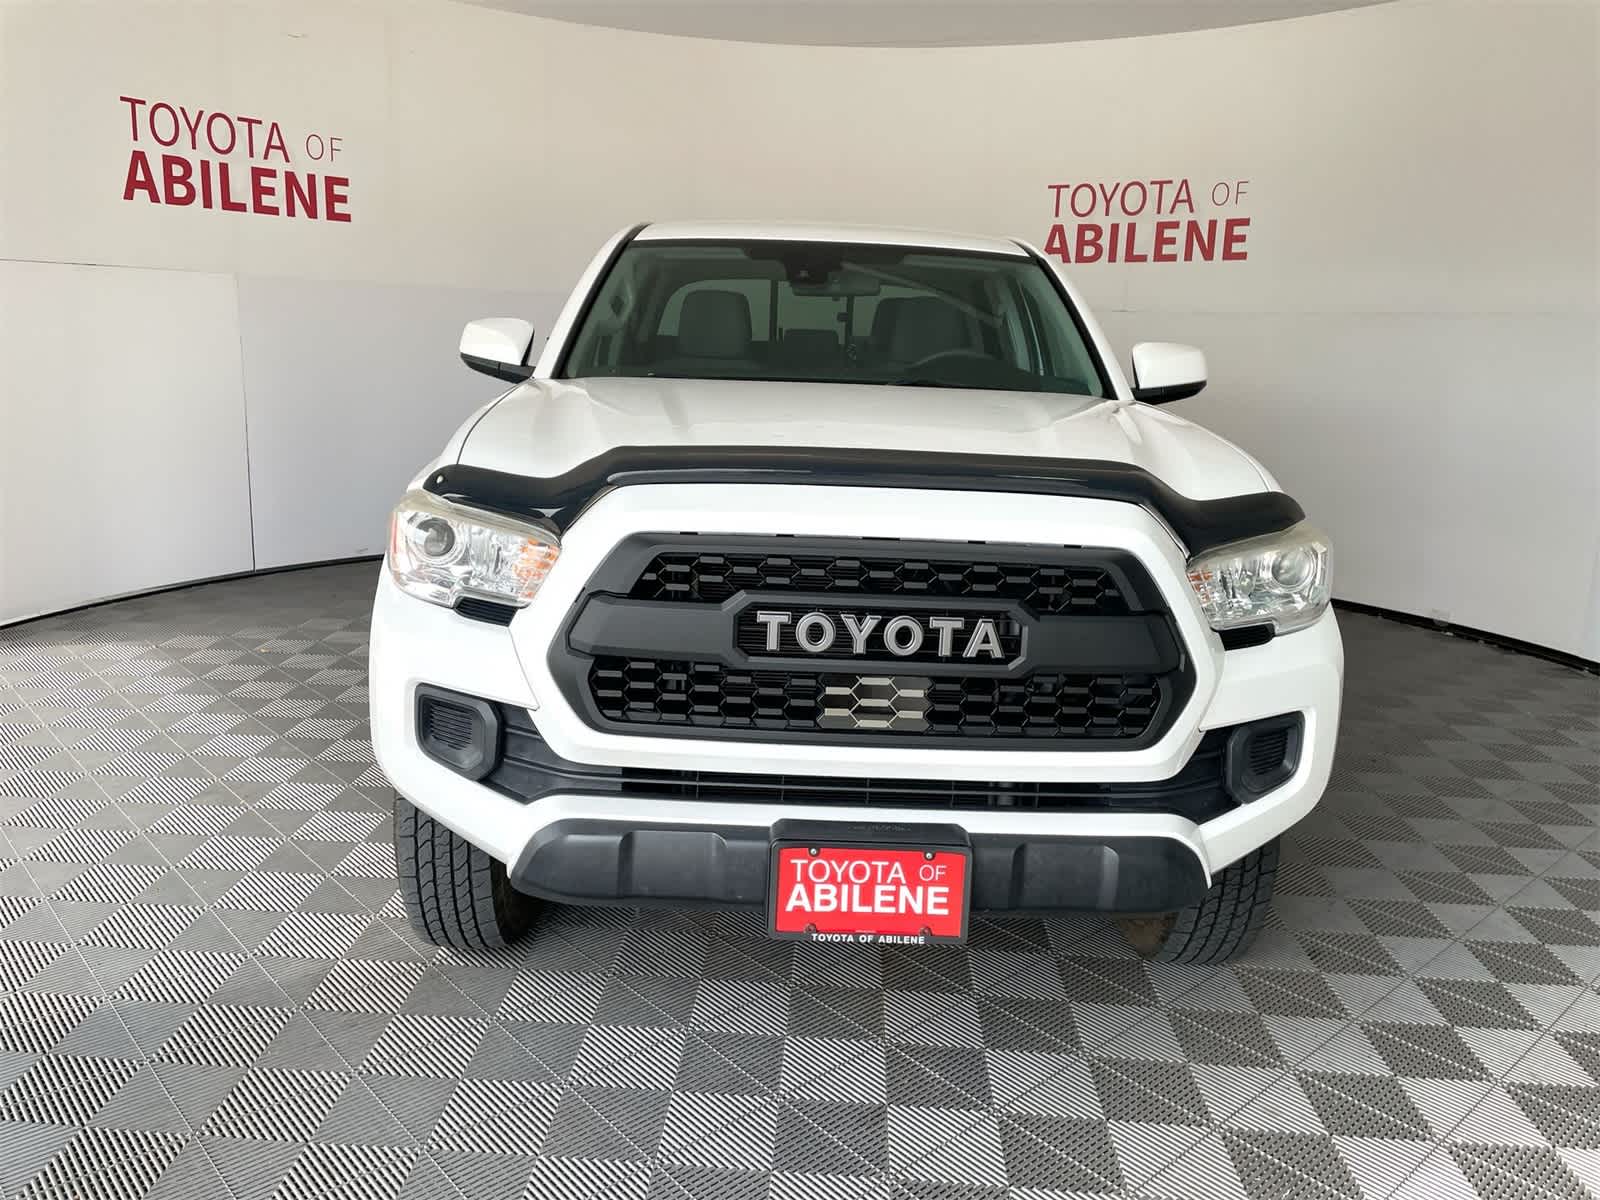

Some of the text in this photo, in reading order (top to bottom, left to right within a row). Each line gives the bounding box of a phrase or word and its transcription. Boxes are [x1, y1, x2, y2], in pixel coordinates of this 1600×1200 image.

[120, 96, 343, 163] TOYOTA OF
[123, 150, 352, 223] ABILENE
[1047, 179, 1249, 218] TOYOTA OF
[1044, 217, 1251, 264] ABILENE
[757, 610, 1005, 659] TOYOTA
[790, 859, 947, 884] TOYOTA OF
[785, 883, 949, 915] ABILENE
[811, 933, 925, 944] TOYOTA OF ABILENE
